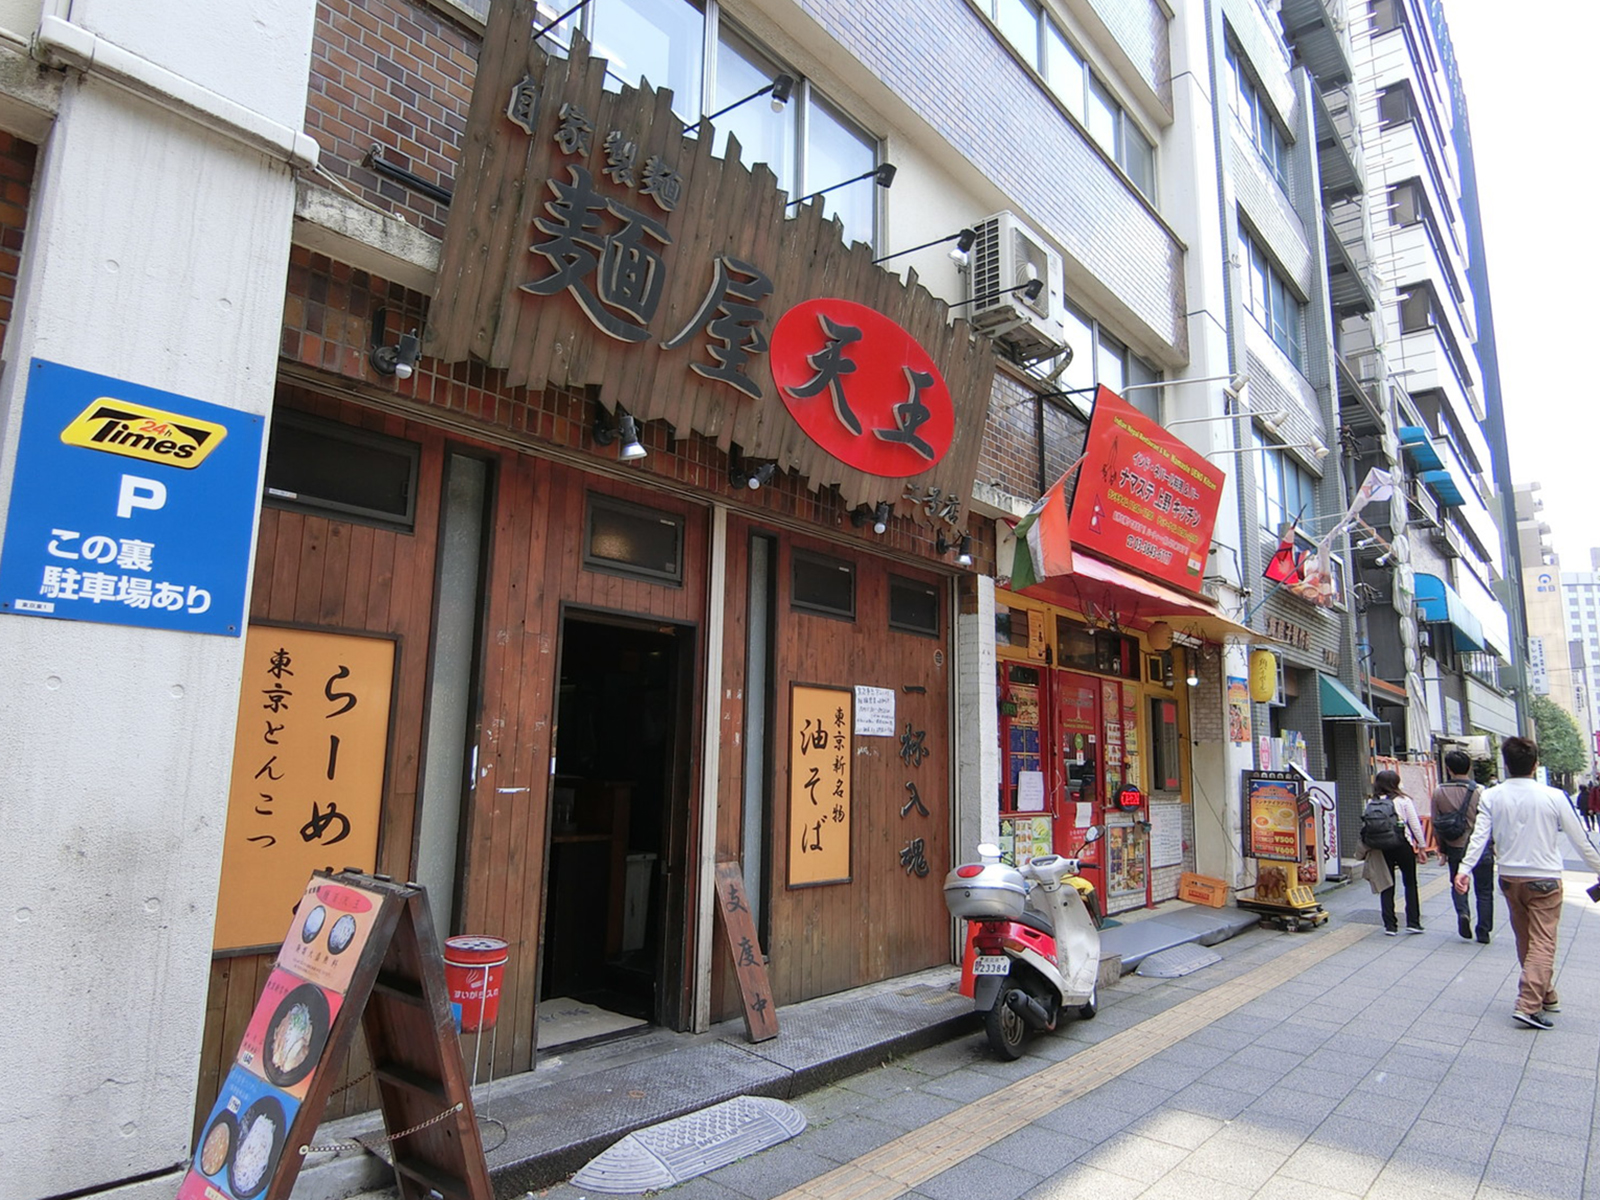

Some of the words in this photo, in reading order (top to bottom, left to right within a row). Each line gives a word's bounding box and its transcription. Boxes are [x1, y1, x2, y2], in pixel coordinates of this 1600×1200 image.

[504, 73, 684, 212] 自家製麺
[519, 164, 775, 400] 麺屋
[88, 409, 202, 459] Times
[117, 474, 167, 519] P
[1119, 467, 1155, 501] ナマステ
[1171, 496, 1202, 528] キッチン
[40, 565, 212, 614] 駐車場あり
[48, 528, 155, 572] この裏
[246, 647, 295, 849] 東京とんこつ
[292, 664, 358, 916] らーめ
[799, 718, 829, 854] 油そば
[832, 706, 846, 823] 東京新名物
[899, 684, 930, 878] 一杯入魂
[726, 883, 768, 1025] 支度中
